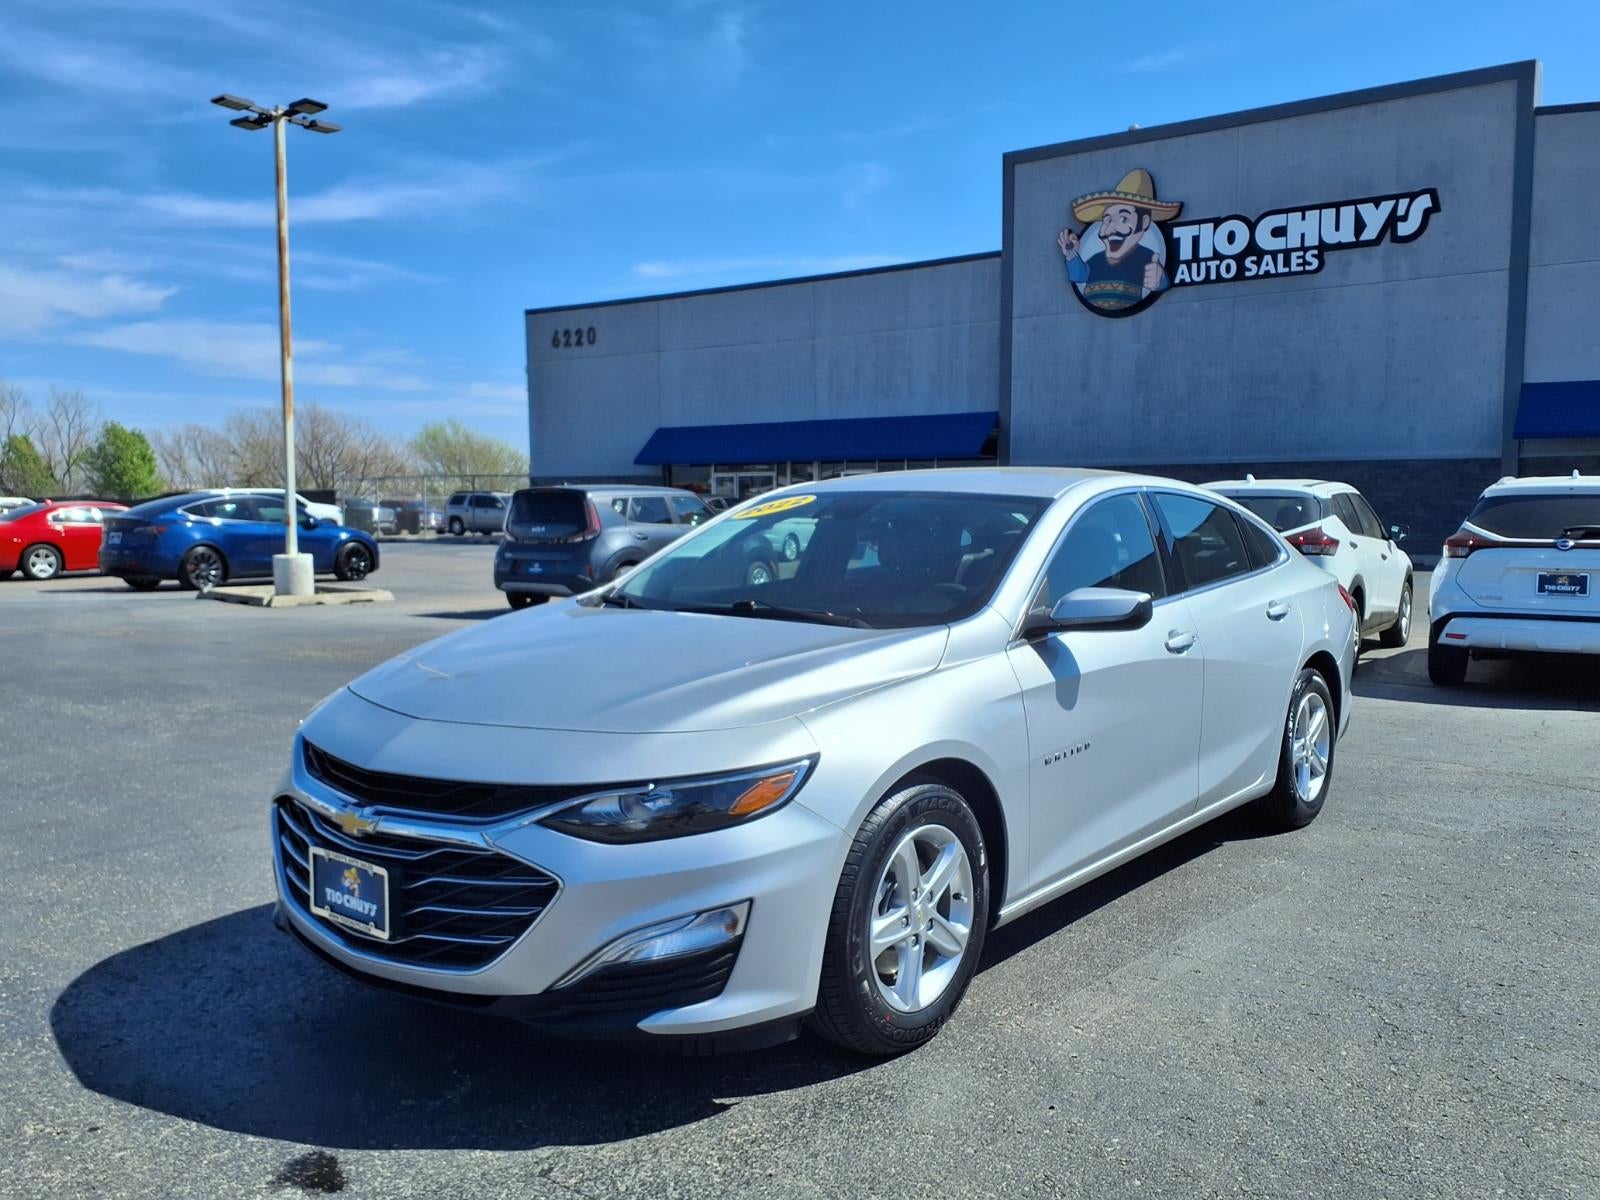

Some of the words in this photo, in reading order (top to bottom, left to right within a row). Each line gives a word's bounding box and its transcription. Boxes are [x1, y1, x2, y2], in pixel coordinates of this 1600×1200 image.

[1173, 219, 1250, 261] TIO
[1254, 193, 1432, 250] CHUY'S
[1174, 259, 1236, 284] AUTO
[1244, 249, 1319, 278] SALES
[551, 326, 596, 348] 6220
[325, 887, 343, 905] TIO
